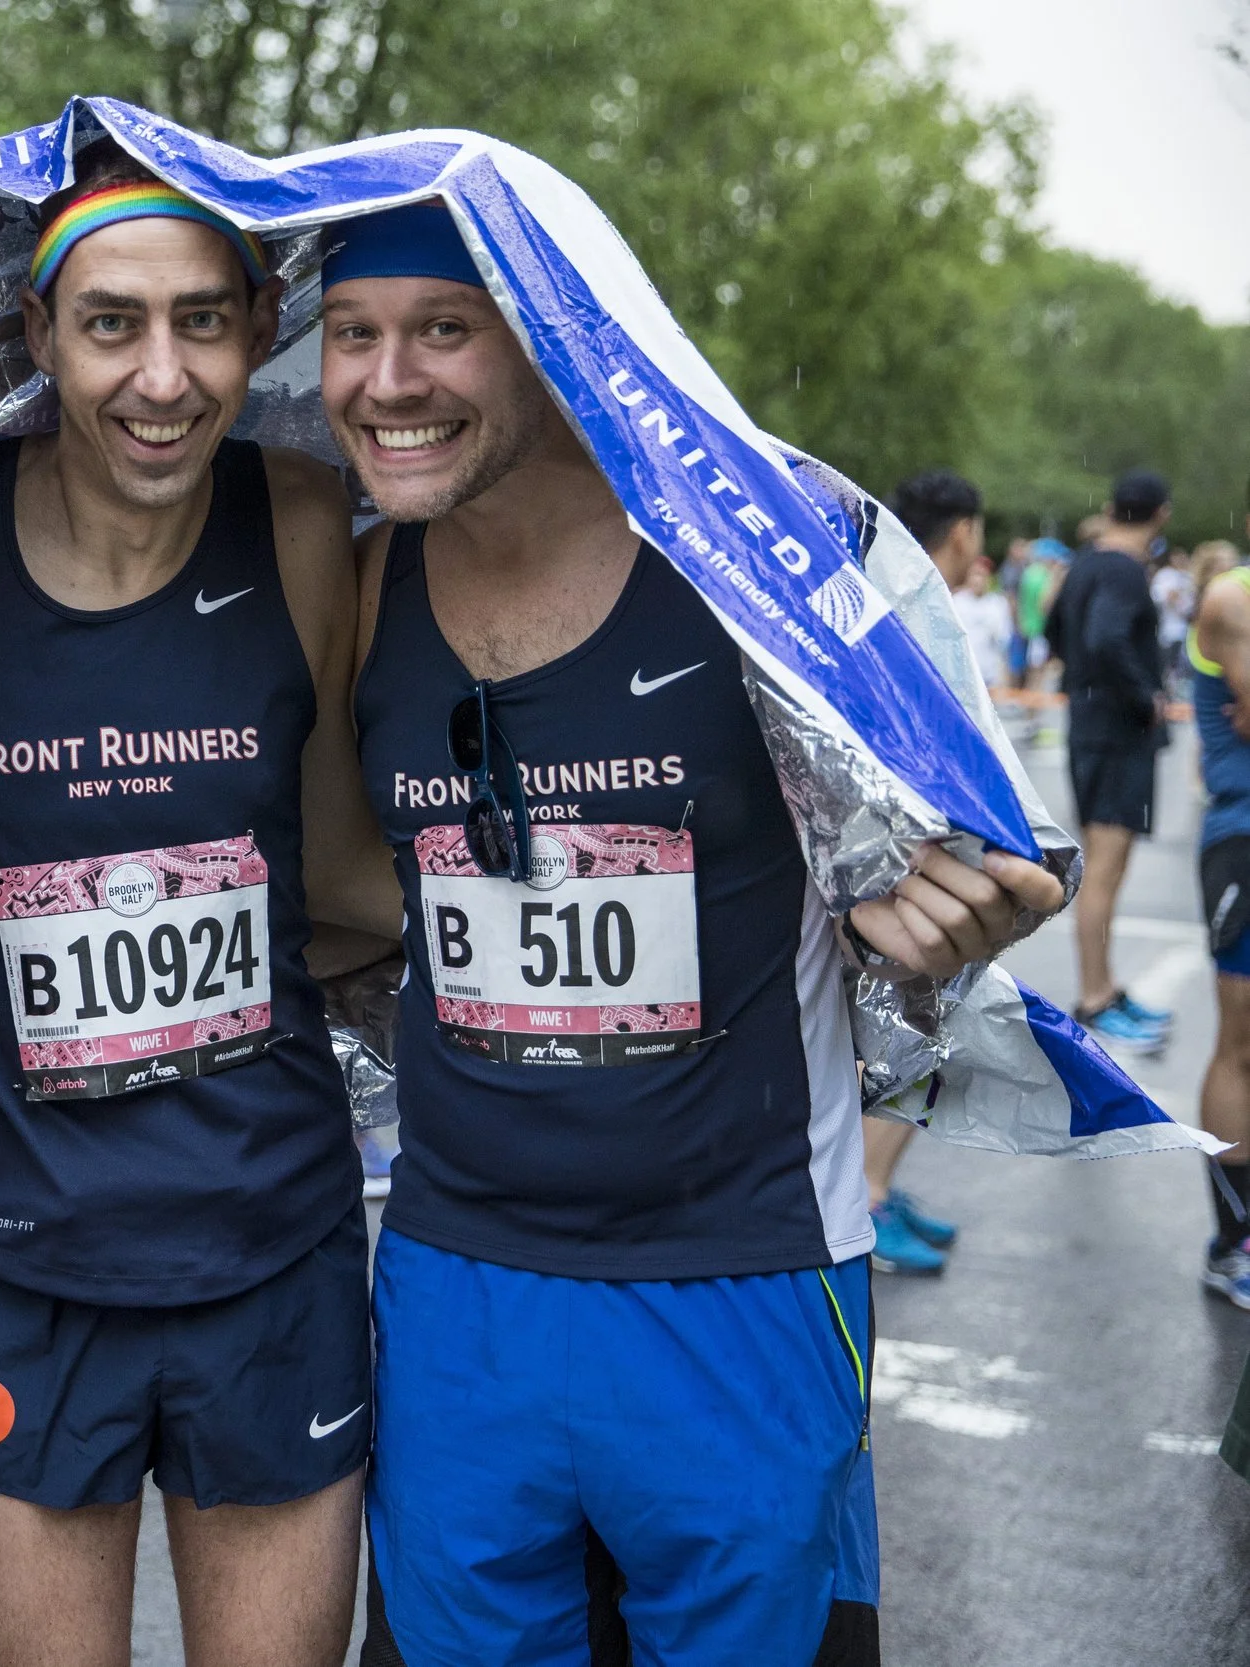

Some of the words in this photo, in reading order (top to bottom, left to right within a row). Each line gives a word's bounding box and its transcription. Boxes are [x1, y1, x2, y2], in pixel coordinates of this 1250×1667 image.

[607, 369, 812, 576] UNITED
[653, 497, 680, 524] fly
[676, 523, 712, 554] the
[708, 550, 786, 620] friendly
[98, 725, 260, 768] RUNNERS
[68, 778, 113, 799] NEW
[118, 776, 174, 795] YORK
[394, 772, 494, 809] FRON
[517, 755, 685, 797] RUNNERS
[527, 804, 582, 822] YORK
[531, 857, 565, 867] OOKLYN
[531, 867, 553, 877] HALF
[108, 882, 154, 897] BROOKLYN
[121, 893, 143, 905] HALF
[436, 904, 473, 969] B
[519, 900, 636, 988] 510
[20, 952, 61, 1017] B
[66, 908, 260, 1020] 10924
[529, 1011, 562, 1027] WAVE
[565, 1010, 571, 1026] 1
[129, 1034, 162, 1052] WAVE
[163, 1032, 170, 1046] 1
[625, 1043, 675, 1056] #AirbnbBKHalf
[214, 1045, 253, 1063] #AirbnbBKHalf
[522, 1046, 582, 1058] NYRR
[56, 1077, 87, 1090] airbnb
[125, 1065, 181, 1085] NYRR
